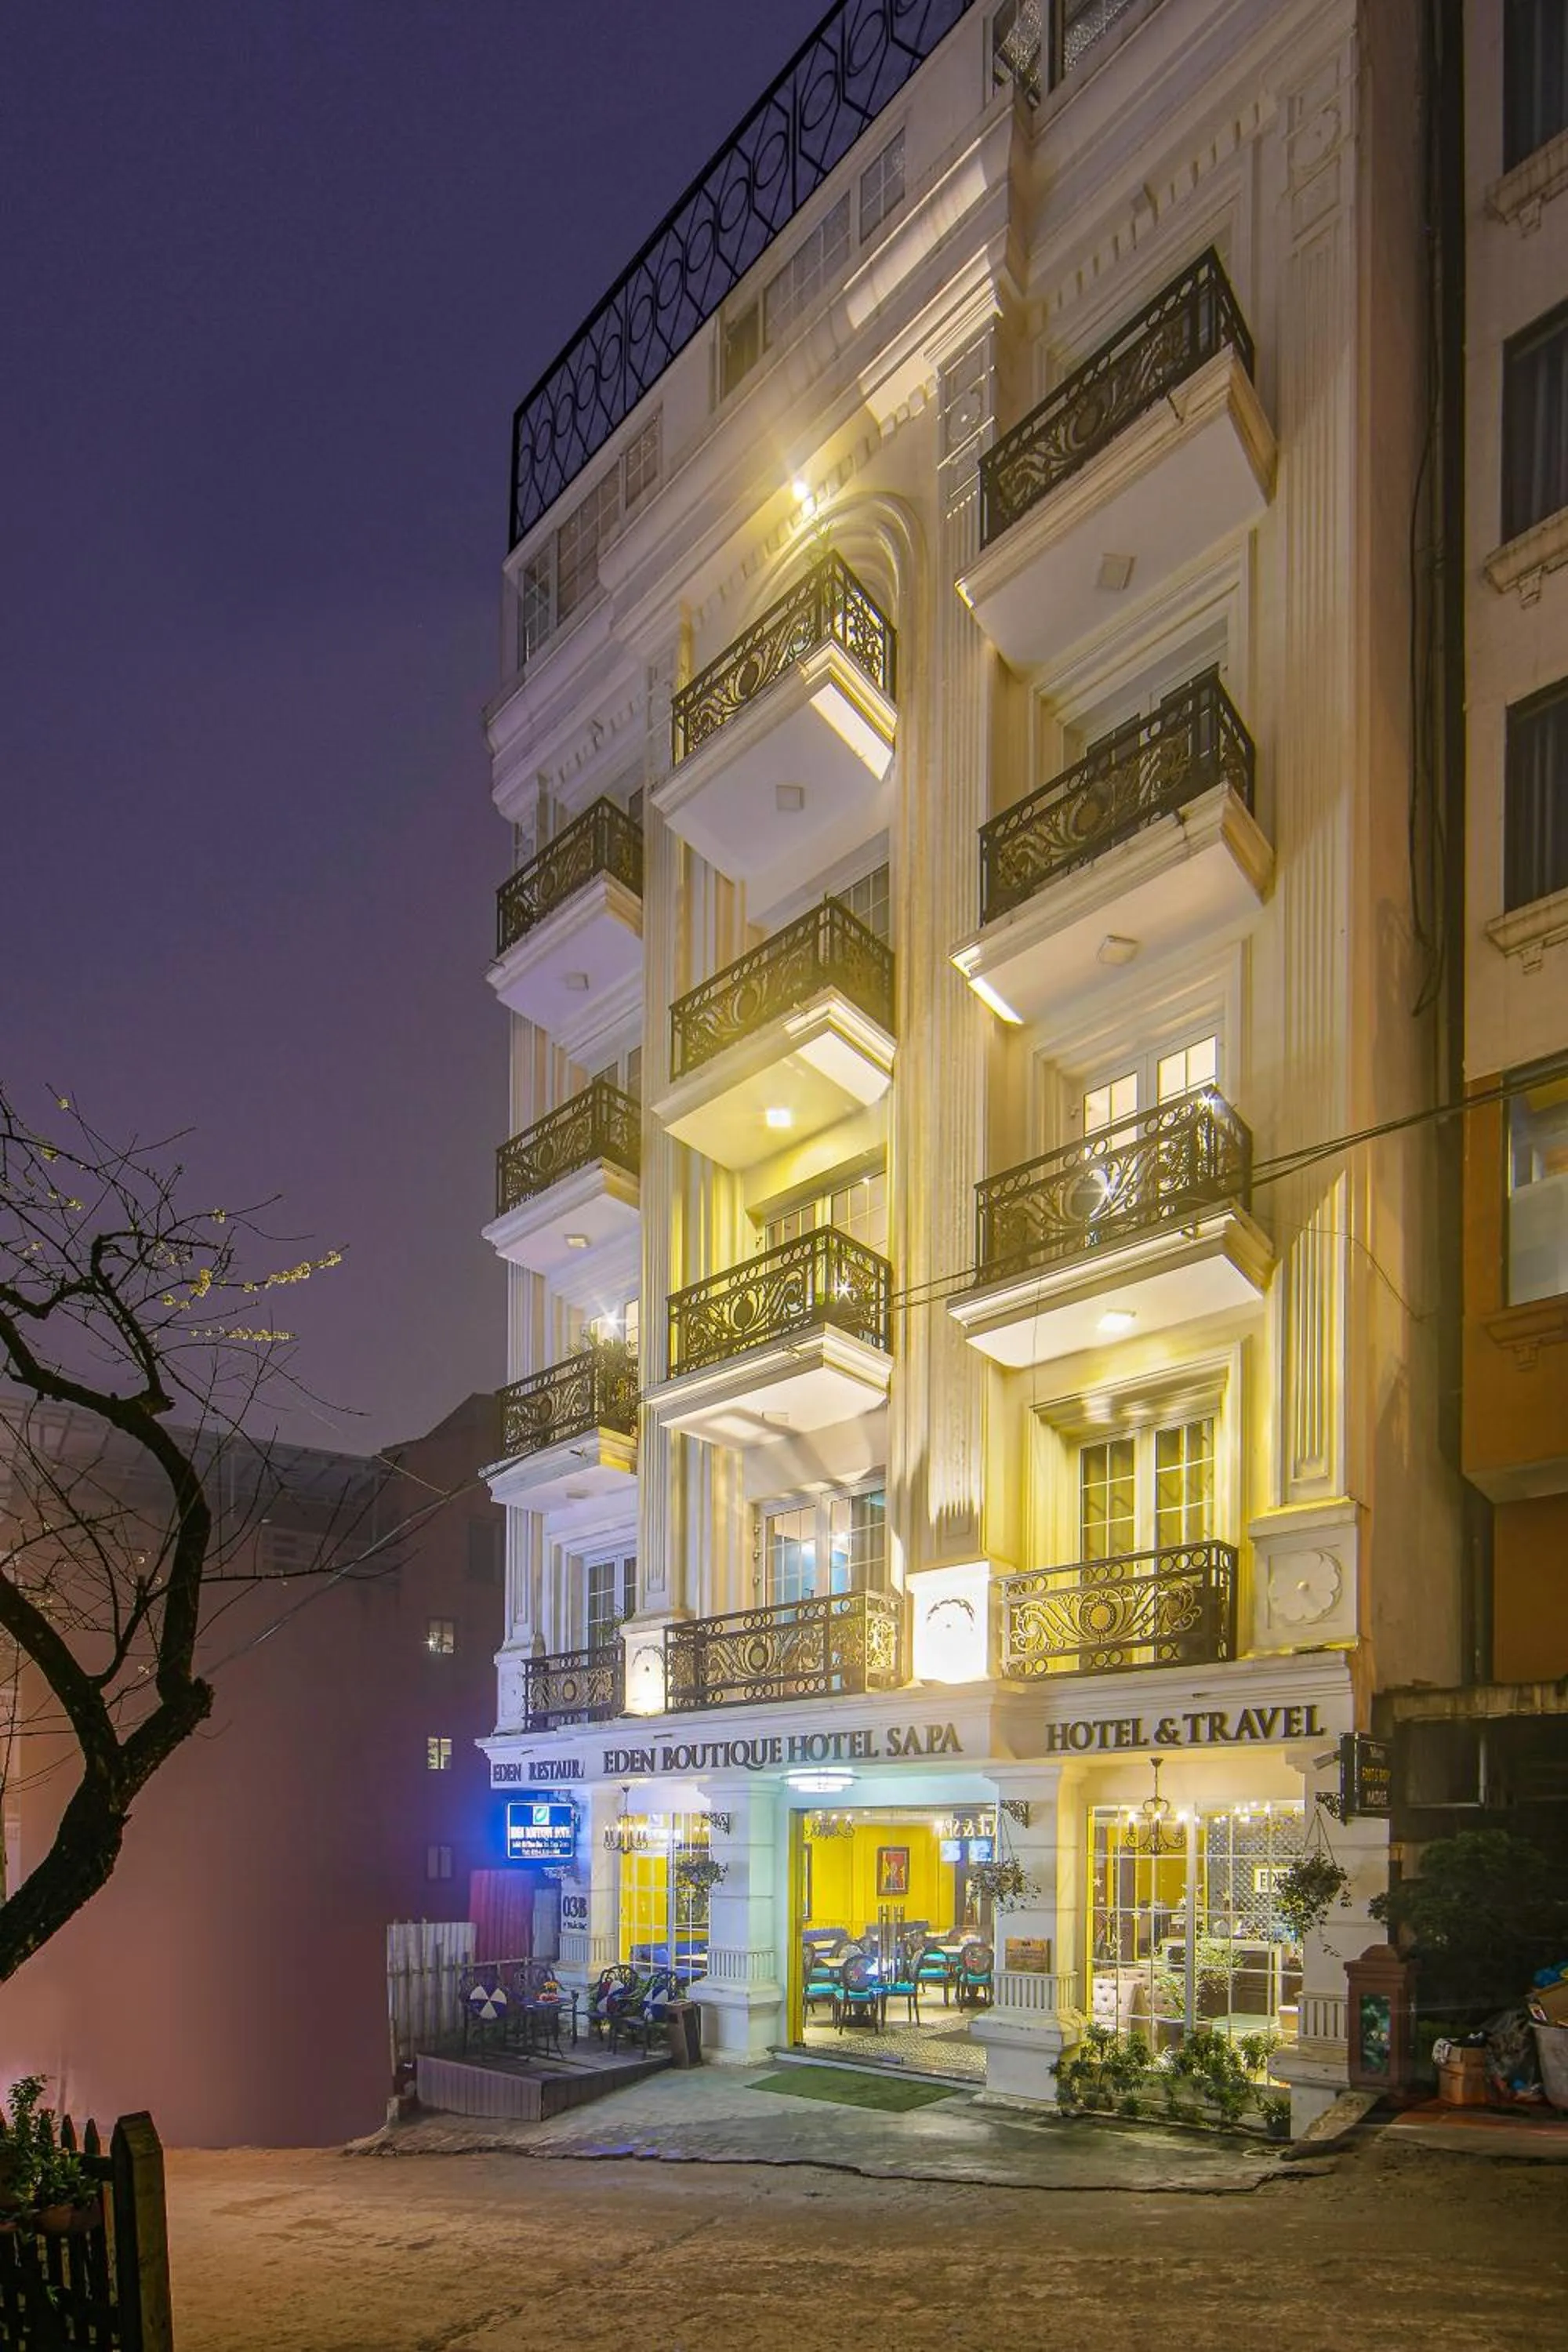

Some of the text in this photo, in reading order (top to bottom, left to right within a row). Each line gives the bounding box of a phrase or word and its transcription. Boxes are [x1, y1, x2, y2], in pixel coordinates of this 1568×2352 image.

[1045, 1704, 1326, 1751] HOTEL & TRAVEL
[603, 1722, 964, 1773] EDEN BOUTIQUE HOTEL SAPA
[493, 1763, 521, 1782] EDEN
[563, 1896, 587, 1918] 03B
